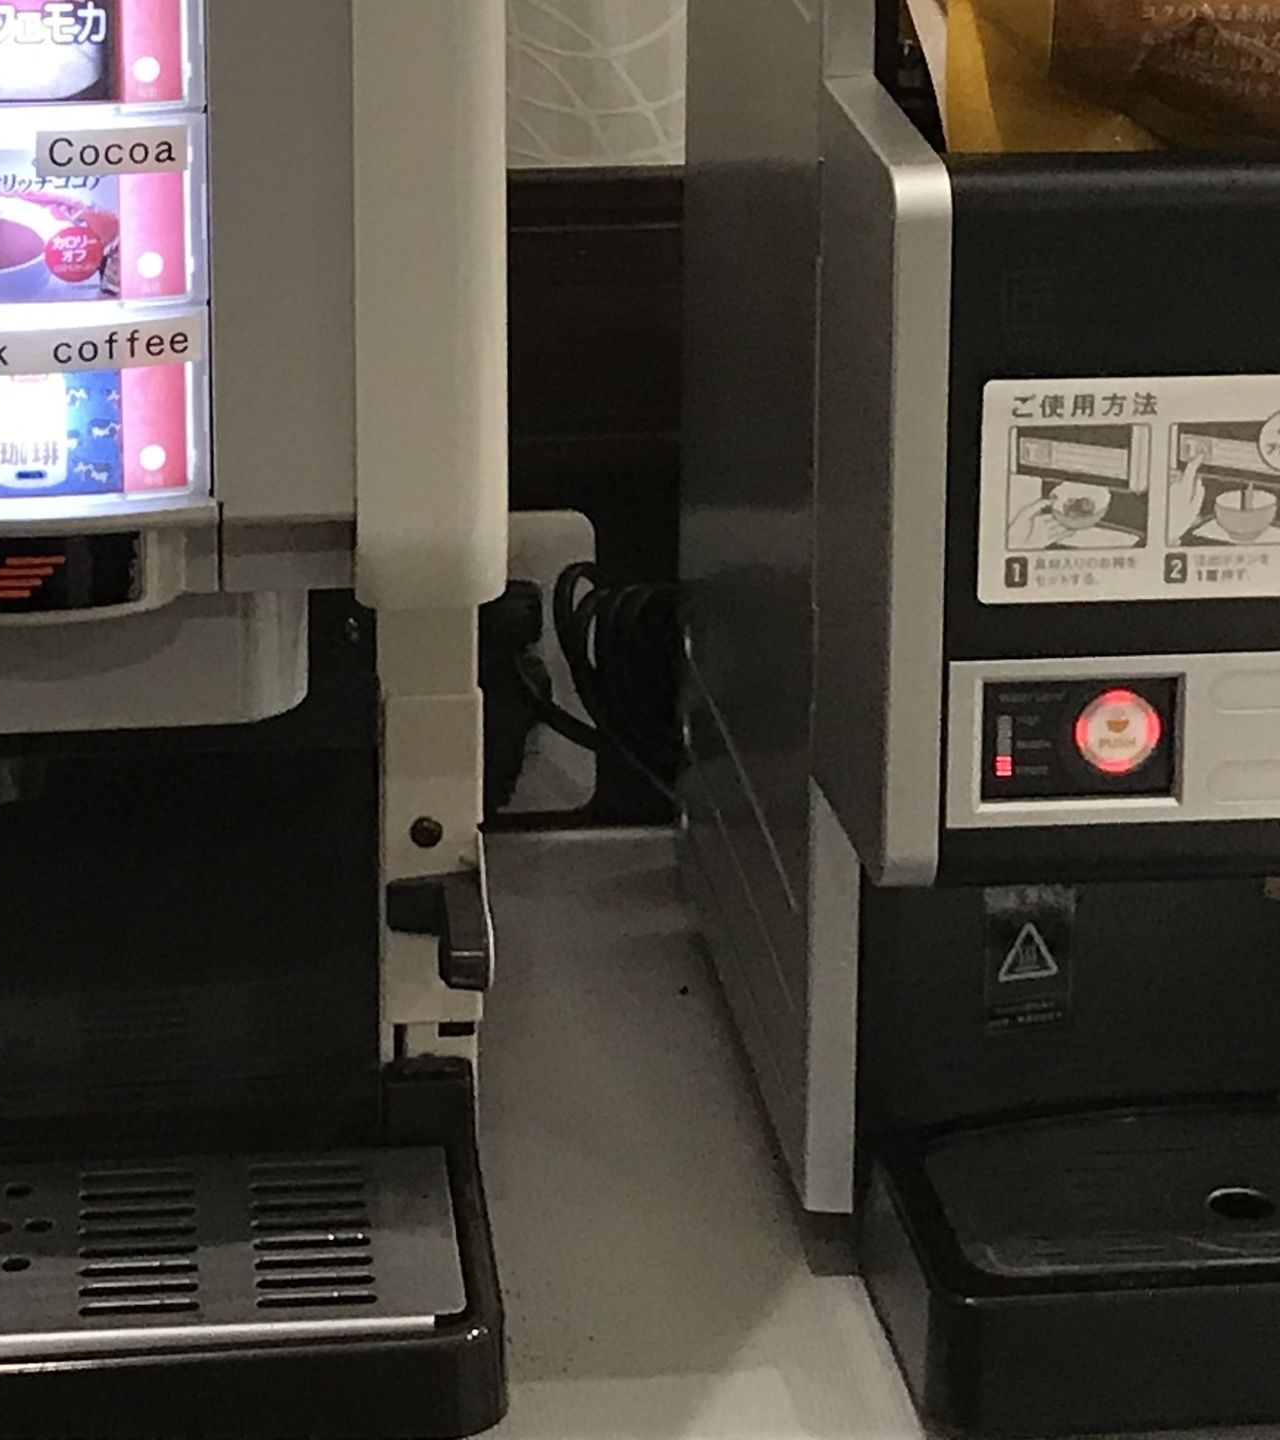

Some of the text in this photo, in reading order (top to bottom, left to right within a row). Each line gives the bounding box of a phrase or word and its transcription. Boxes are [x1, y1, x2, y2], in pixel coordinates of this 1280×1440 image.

[48, 137, 177, 167] Cocoa
[52, 236, 97, 249] カロリー
[61, 249, 88, 262] オフ
[53, 330, 190, 365] coffee
[1010, 392, 1160, 419] ご使用方法
